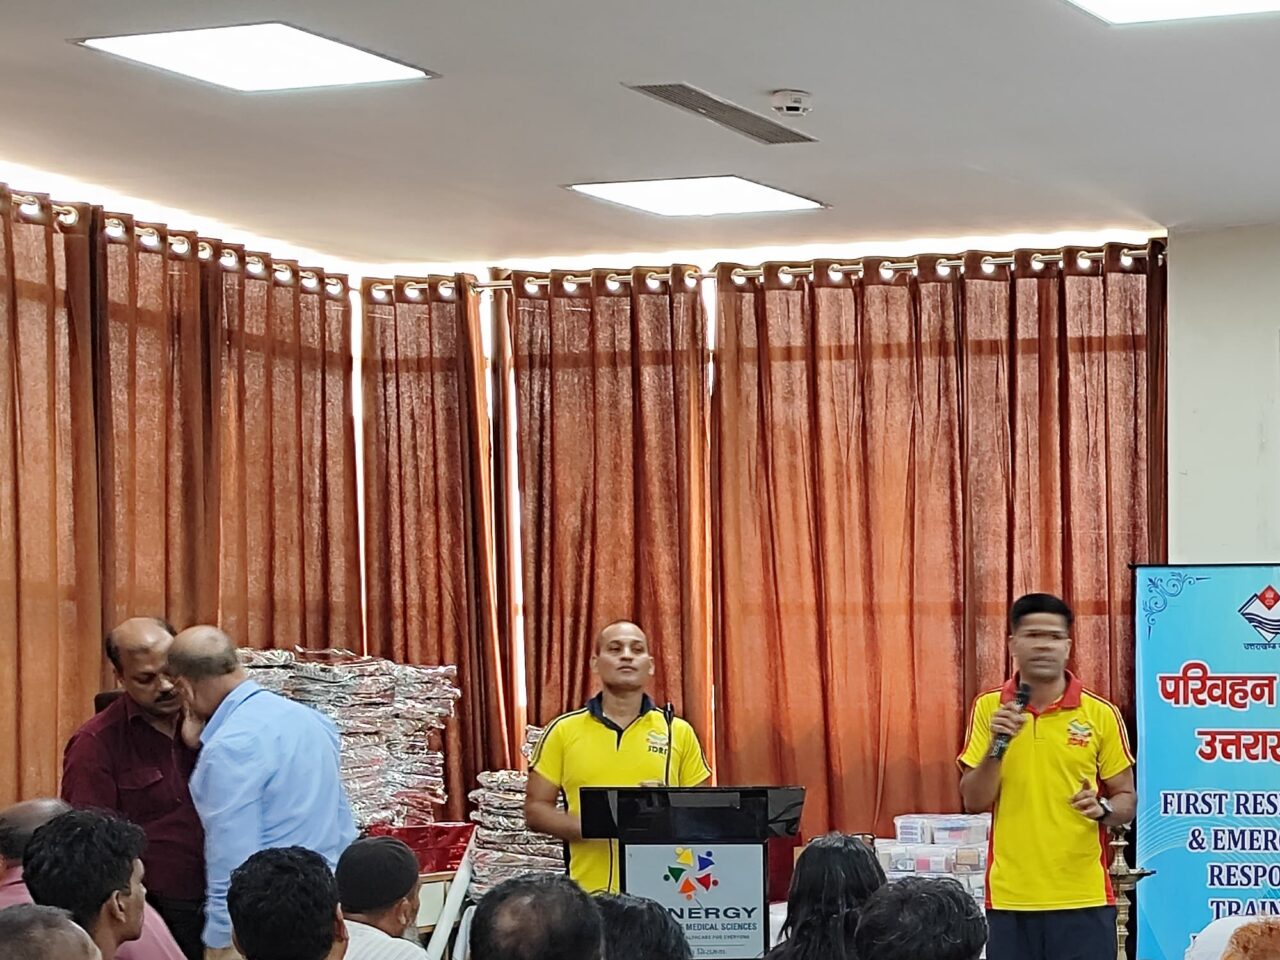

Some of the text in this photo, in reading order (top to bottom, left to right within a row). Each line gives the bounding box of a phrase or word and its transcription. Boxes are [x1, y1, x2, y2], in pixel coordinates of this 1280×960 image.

[1158, 661, 1277, 709] परिवहन
[1161, 792, 1228, 816] FIRST
[1187, 828, 1206, 850] &
[667, 906, 758, 920] NERGY
[685, 922, 719, 931] MEDICAL
[720, 922, 758, 931] SCIENCES
